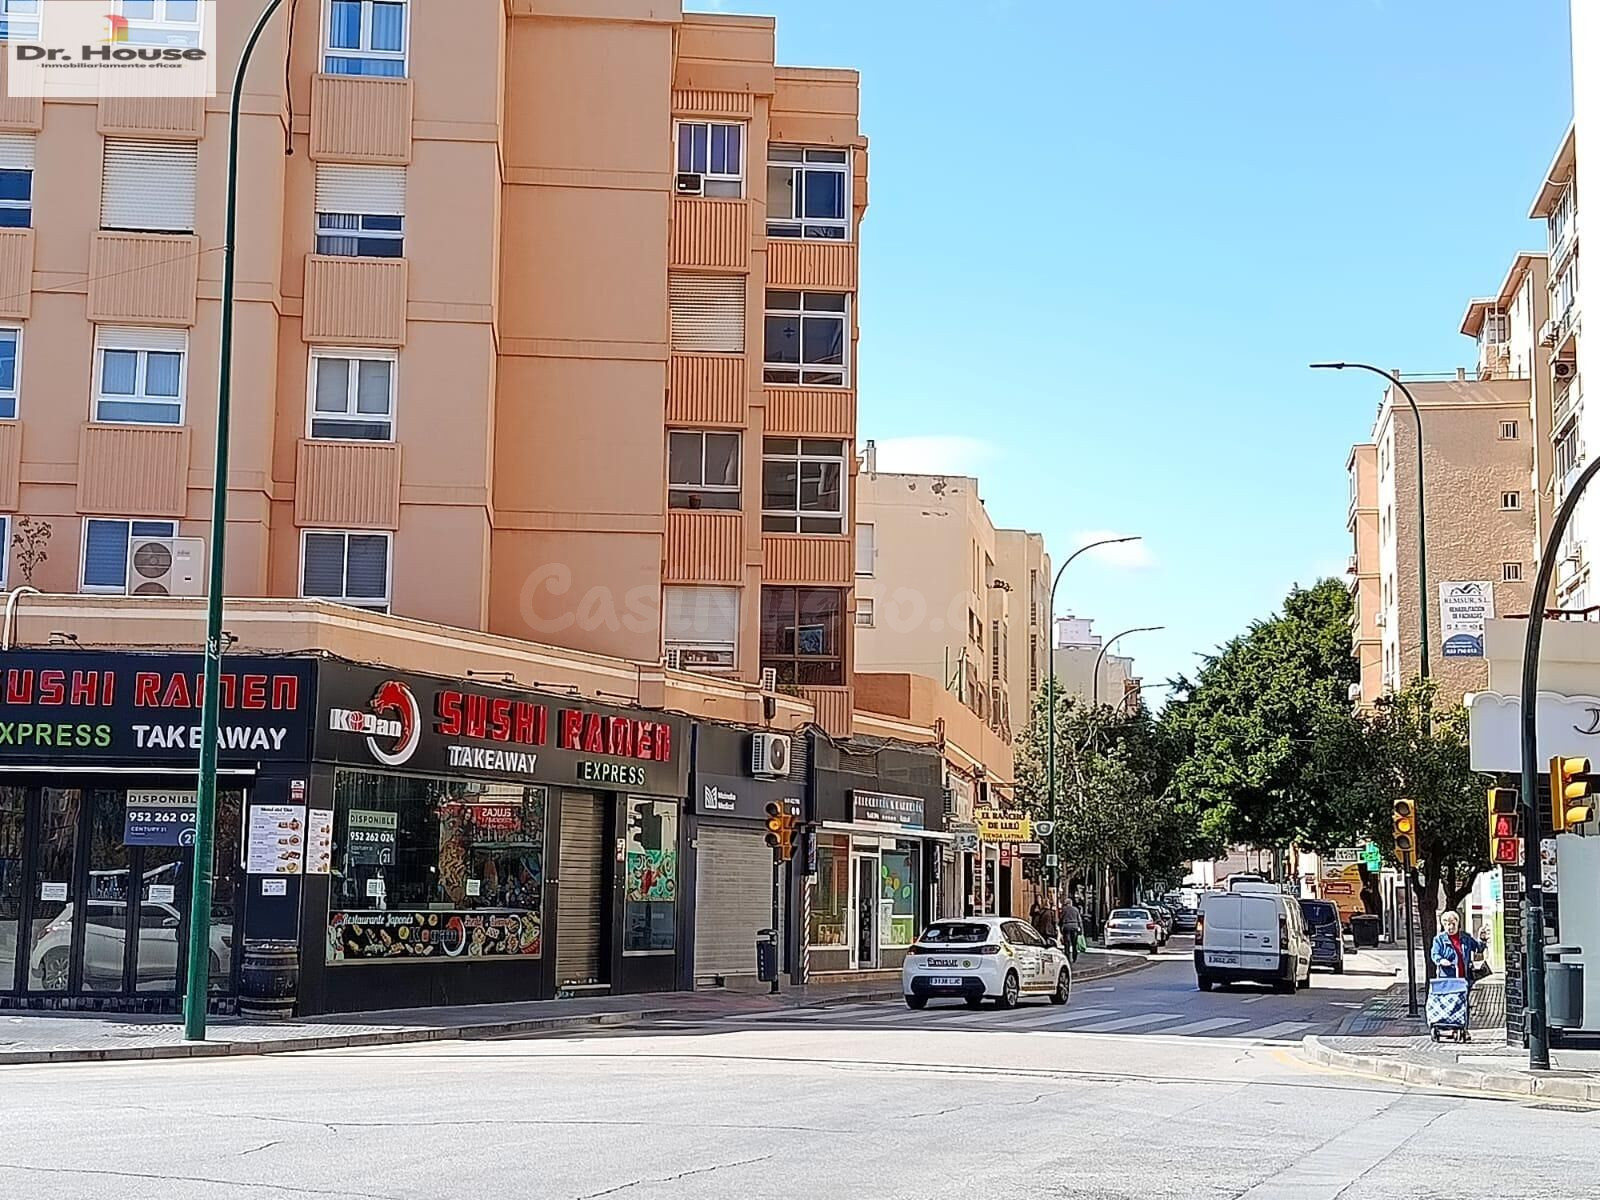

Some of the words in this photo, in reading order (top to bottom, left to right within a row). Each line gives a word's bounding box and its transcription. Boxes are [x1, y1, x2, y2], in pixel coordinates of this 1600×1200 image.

[0, 668, 115, 707] USHI
[438, 689, 548, 746] SUSHI
[561, 708, 672, 763] RAMEN
[132, 725, 287, 751] TAKEAWAY
[448, 745, 538, 775] TAKEAWAY
[583, 760, 647, 787] EXPRESS
[128, 794, 198, 804] DISPONIBL
[129, 811, 152, 823] 952
[154, 812, 178, 824] 262
[180, 812, 197, 824] 02
[351, 814, 396, 826] DISPONIBLE
[988, 821, 999, 829] DE
[350, 831, 365, 841] 952
[365, 832, 380, 843] 262
[380, 833, 395, 843] 024
